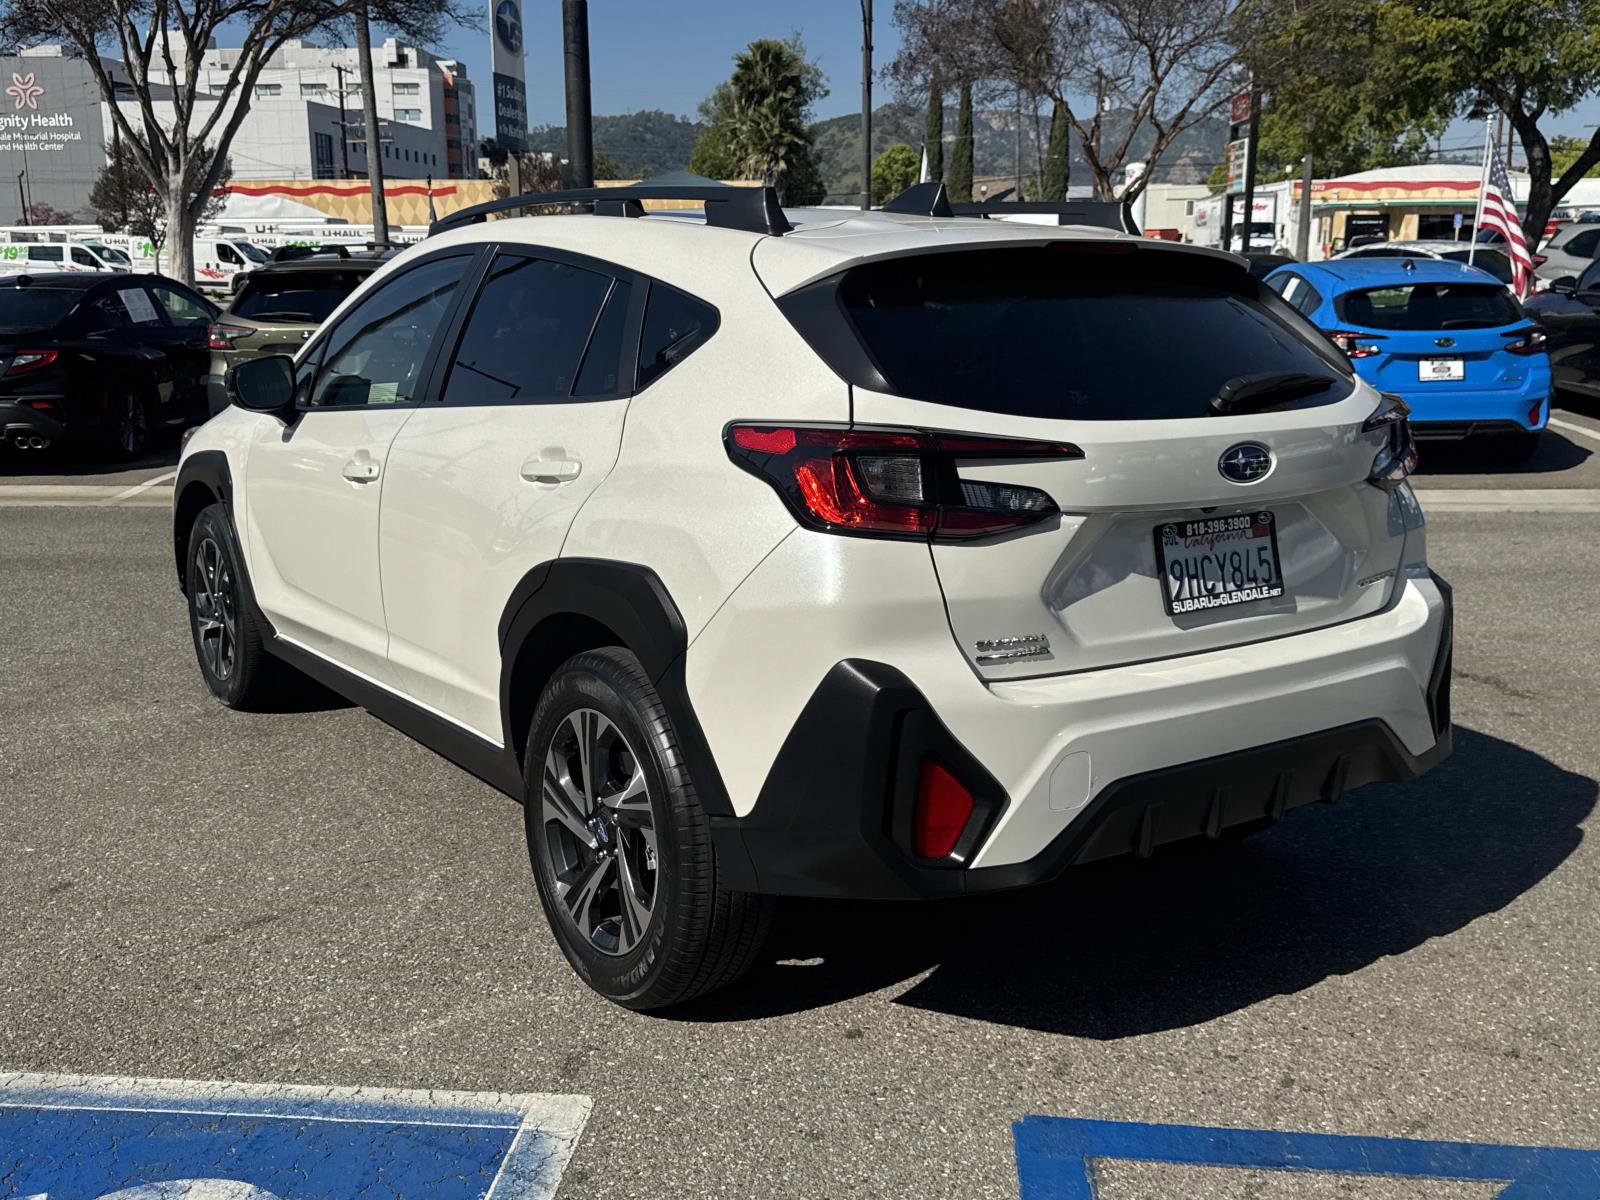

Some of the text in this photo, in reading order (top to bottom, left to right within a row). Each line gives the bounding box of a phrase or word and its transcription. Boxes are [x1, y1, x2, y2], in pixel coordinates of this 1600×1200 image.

[31, 113, 73, 127] Health
[50, 131, 82, 142] Hospital
[13, 142, 38, 151] Health
[39, 142, 65, 151] Center
[1185, 515, 1251, 537] 818-396-3900
[1168, 545, 1274, 601] 9HCY845
